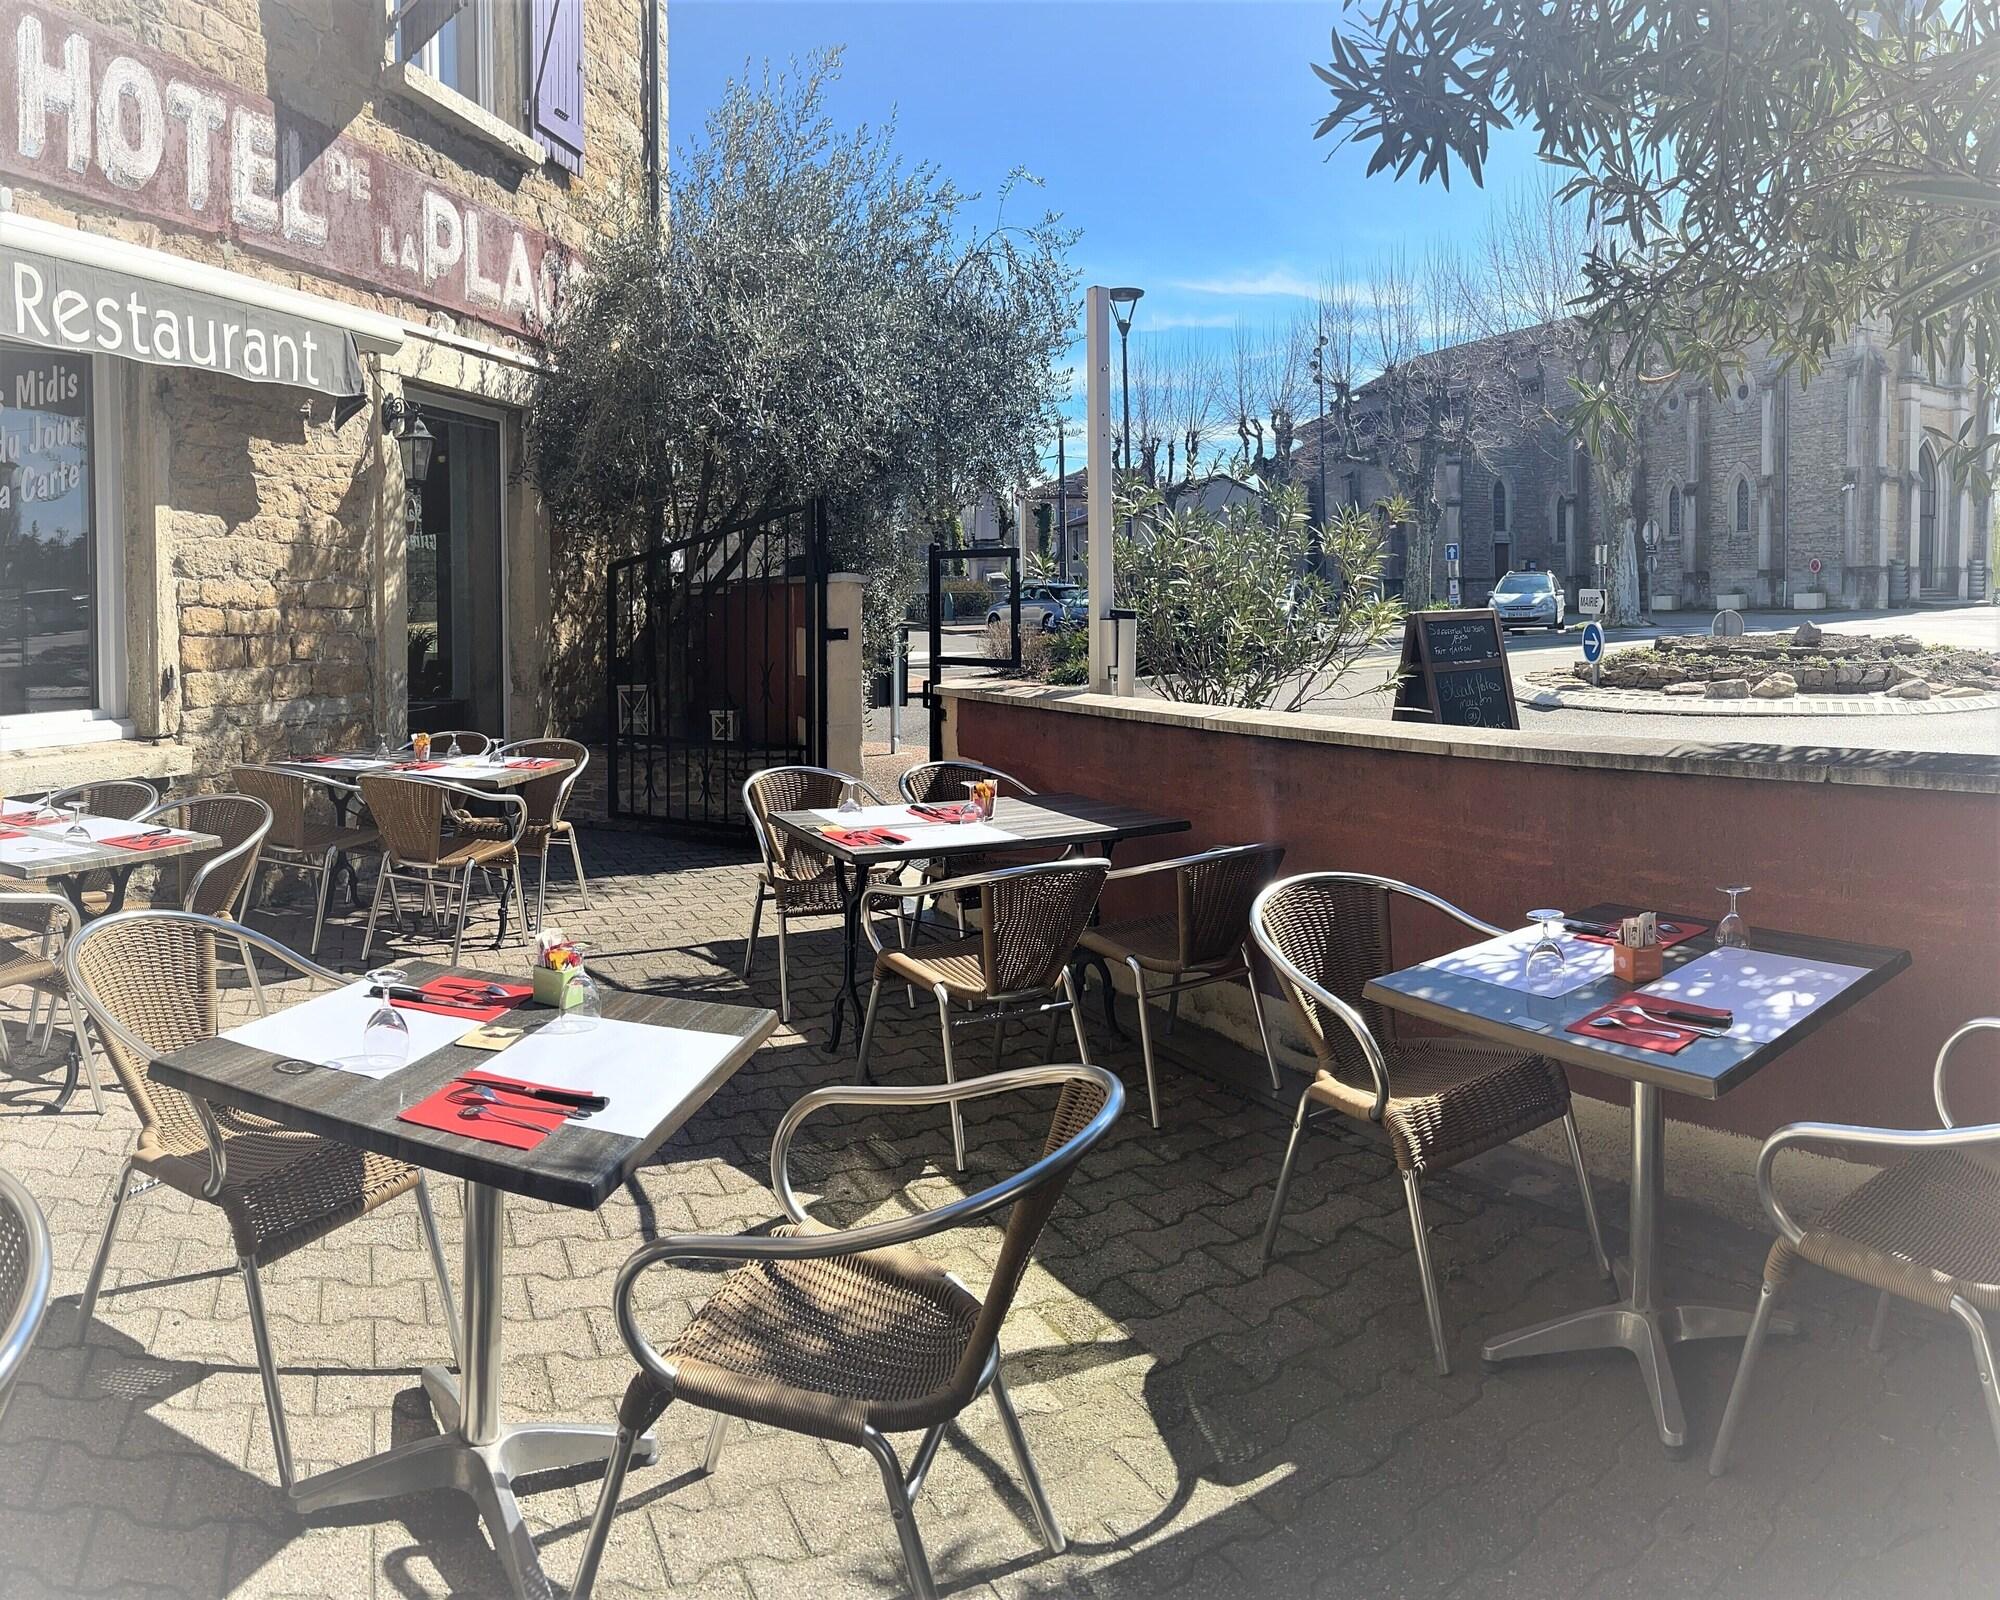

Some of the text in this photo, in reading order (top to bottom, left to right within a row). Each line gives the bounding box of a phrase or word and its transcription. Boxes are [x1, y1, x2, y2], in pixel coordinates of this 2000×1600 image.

[15, 14, 329, 249] HOTEL
[325, 148, 371, 201] DE
[381, 226, 419, 274] LA
[15, 261, 320, 387] Restaurant
[16, 365, 78, 410] Midis
[29, 415, 81, 454] Jour
[20, 461, 80, 502] Carte
[1580, 596, 1599, 607] MAIRIE
